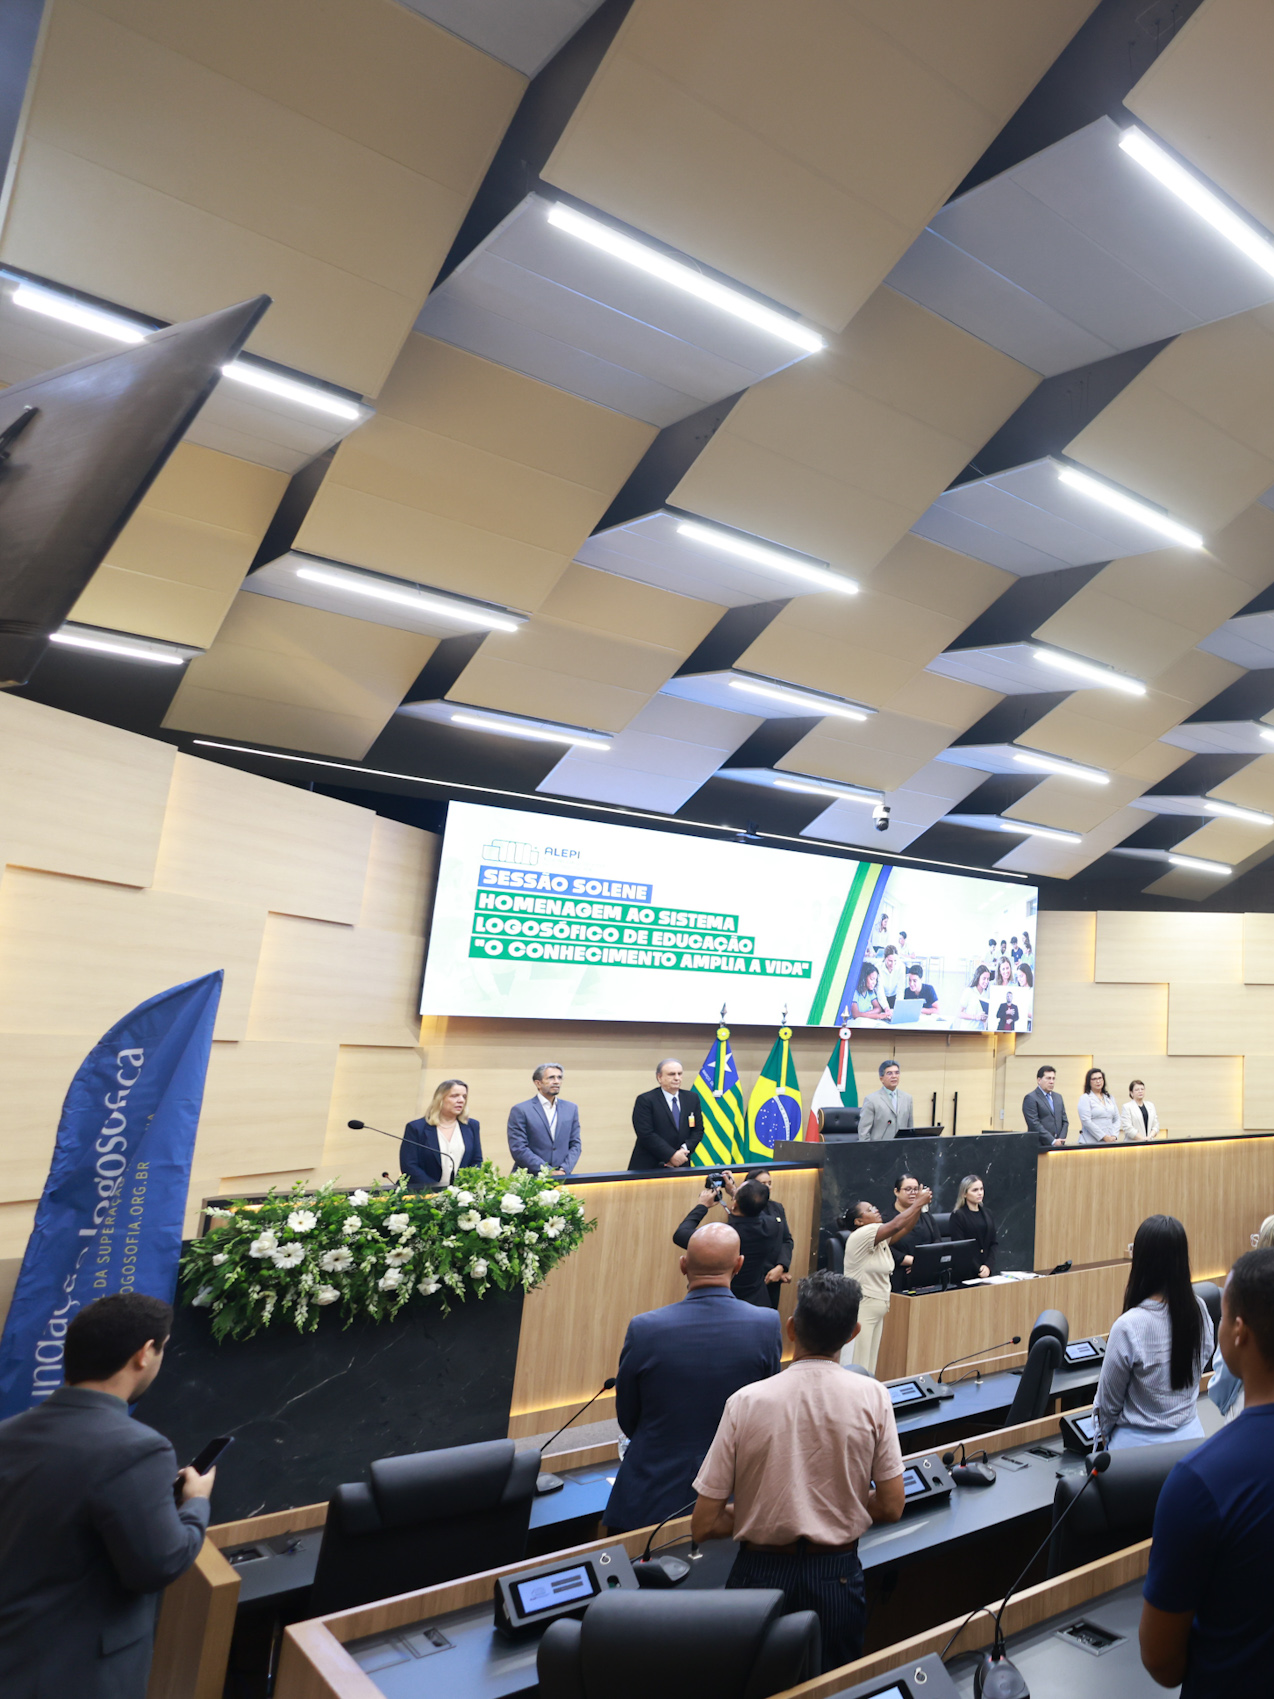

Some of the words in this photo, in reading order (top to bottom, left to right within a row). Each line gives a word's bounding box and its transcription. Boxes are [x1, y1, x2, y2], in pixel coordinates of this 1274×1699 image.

[544, 846, 580, 859] ALEPI
[482, 869, 569, 892] SESSÃO
[572, 878, 648, 900] SOLENE
[478, 892, 622, 921] HOMENAGEM
[626, 907, 655, 924] AO
[658, 910, 735, 931] SISTEMA
[475, 916, 620, 942] LOGOSÓFICO
[623, 928, 649, 944] DE
[652, 931, 753, 953] EDUCAÇÃO
[508, 941, 677, 967] CONHECIMENTO
[680, 954, 746, 972] AMPLIA
[749, 958, 761, 973] A
[120, 1161, 150, 1295] OGOSOFIA.ORG.BR
[94, 1270, 108, 1288] DA
